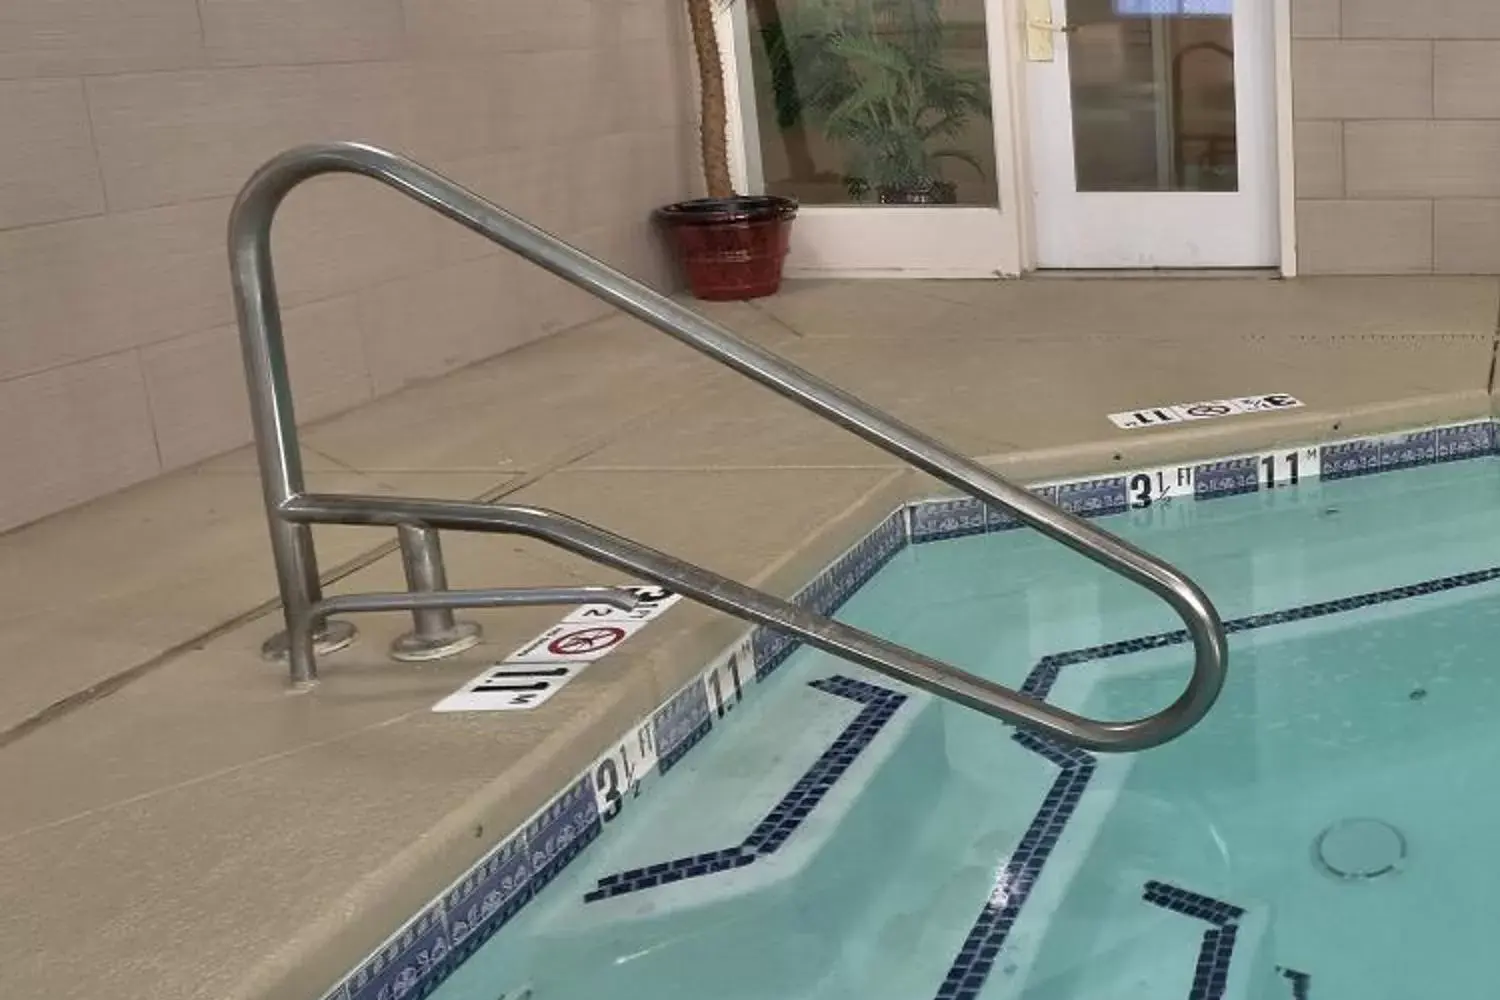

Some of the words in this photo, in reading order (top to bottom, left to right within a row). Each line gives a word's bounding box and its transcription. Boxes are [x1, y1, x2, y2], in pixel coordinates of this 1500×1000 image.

[1131, 473, 1152, 509] 3
[1177, 467, 1191, 487] FT
[470, 667, 569, 693] 1.1
[596, 757, 623, 823] 3
